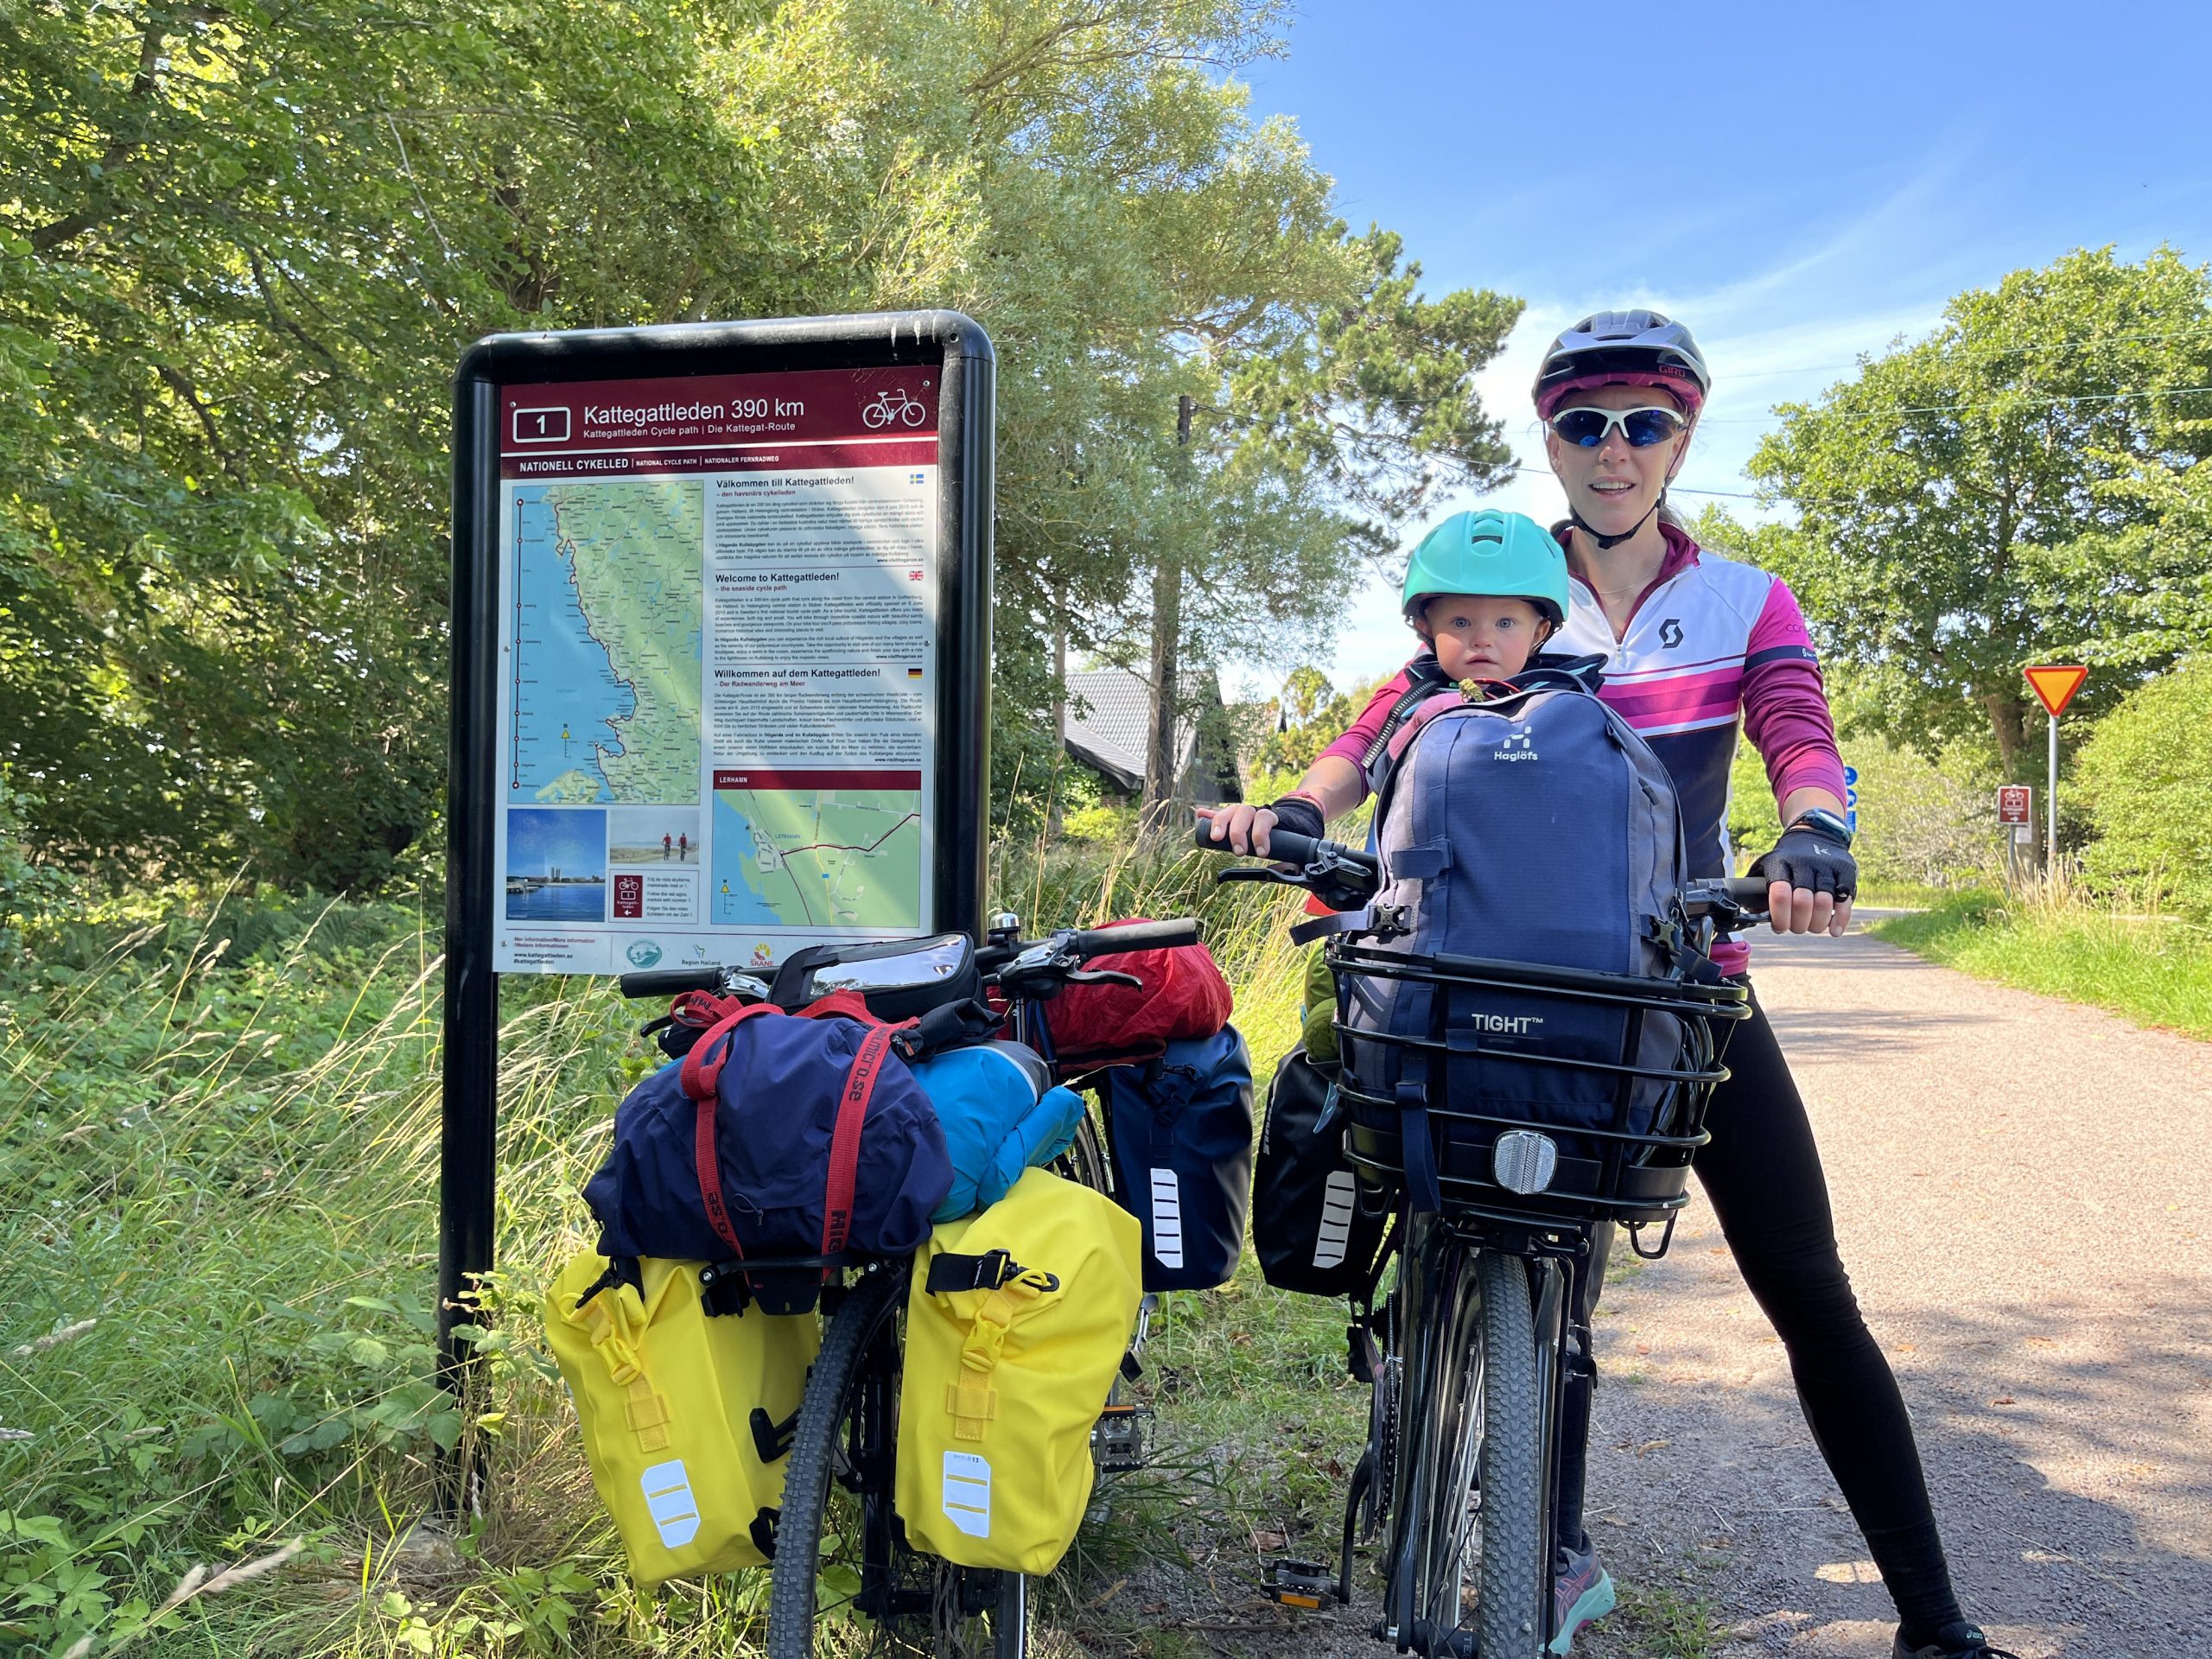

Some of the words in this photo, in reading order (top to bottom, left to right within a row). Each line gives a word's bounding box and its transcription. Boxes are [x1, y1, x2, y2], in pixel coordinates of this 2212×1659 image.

[1659, 365, 1686, 377] GIRO
[583, 404, 725, 429] Kattegattleden
[731, 401, 768, 419] 390
[773, 398, 804, 417] km
[536, 416, 545, 435] 1
[583, 427, 648, 441] Kattegattleden
[651, 425, 677, 437] Cycle
[679, 424, 699, 435] path
[708, 424, 722, 433] Die
[726, 422, 796, 434] Kattegat-Route
[519, 460, 574, 472] NATIONELL
[576, 458, 628, 470] CYKELLED
[636, 459, 662, 467] NATIONAL
[704, 456, 739, 465] NATIONALER
[741, 454, 779, 463] FERNRADWEG
[716, 478, 769, 488] Välkommen
[772, 478, 782, 486] till
[785, 476, 855, 487] Kattegattleden!
[715, 573, 756, 583] Welcome
[771, 572, 839, 583] Kattegattleden!
[811, 669, 880, 679] Kattegattleden!
[1494, 750, 1538, 762] Haglöfs
